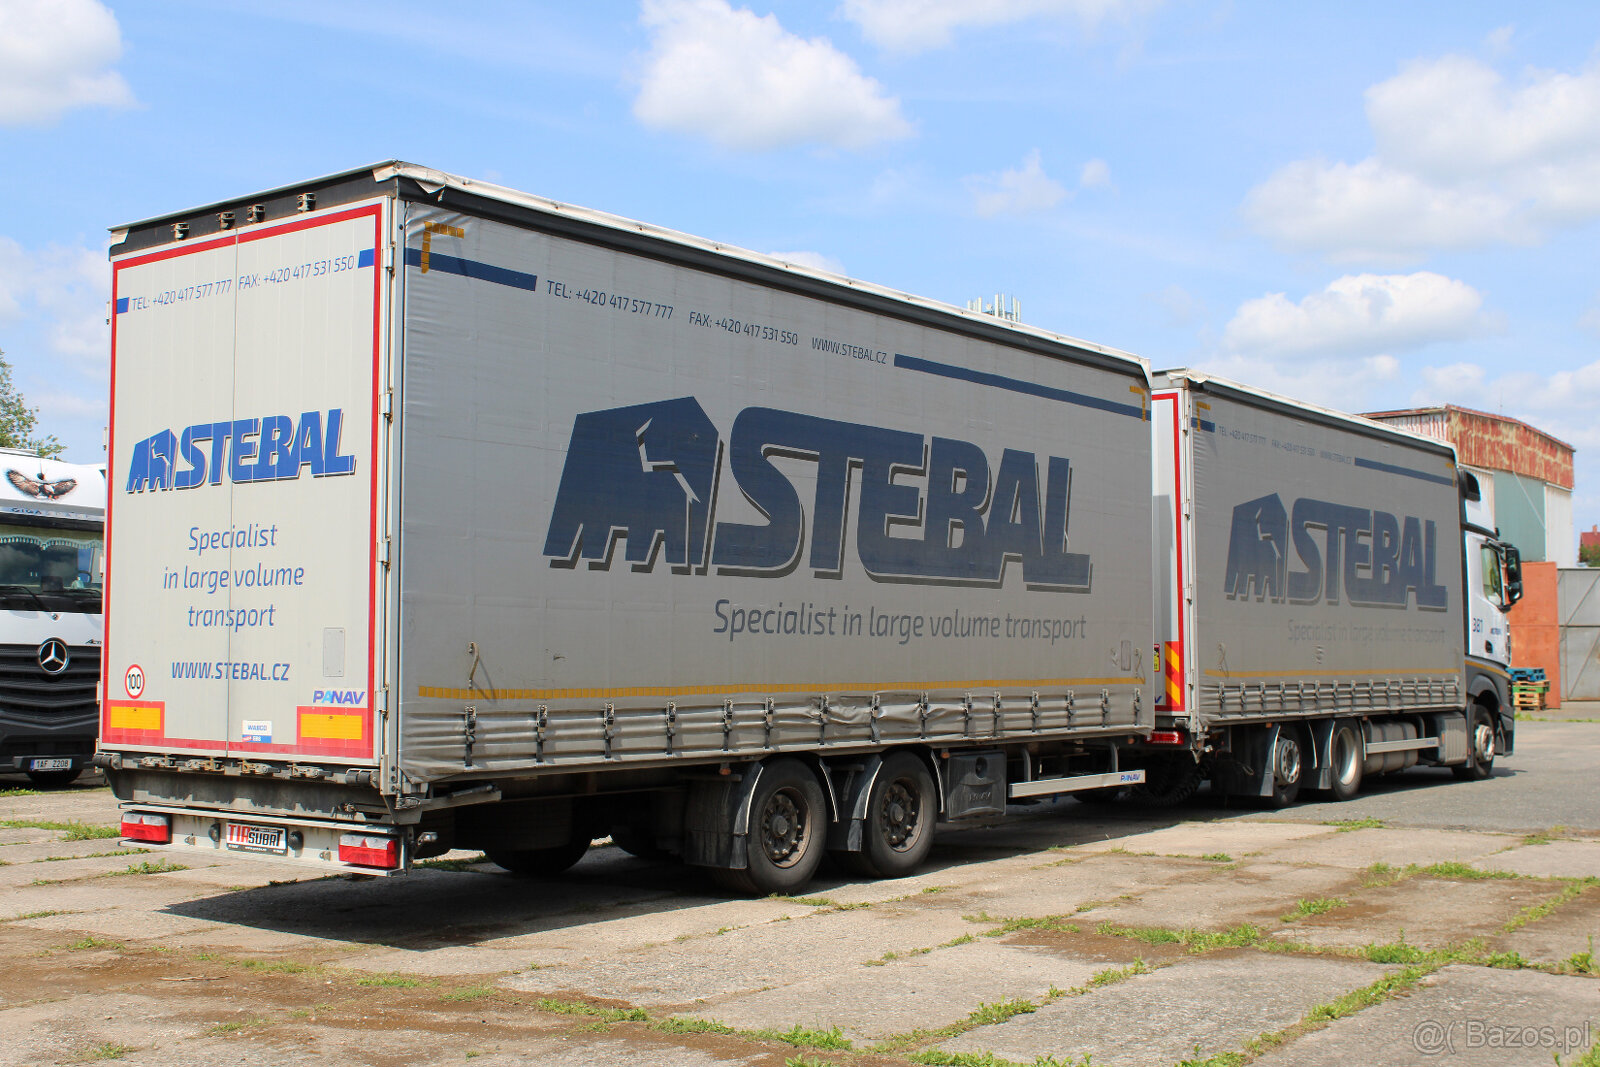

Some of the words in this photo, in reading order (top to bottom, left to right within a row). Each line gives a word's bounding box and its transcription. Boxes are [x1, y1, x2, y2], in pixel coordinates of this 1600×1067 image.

[131, 297, 150, 310] TEL:
[153, 291, 176, 306] +420
[177, 287, 194, 301] 417
[195, 283, 213, 298] 577
[215, 279, 232, 295] 777
[238, 273, 261, 290] FAX:
[263, 267, 290, 283] +420
[293, 263, 311, 279] 417
[313, 260, 331, 277] 531
[333, 255, 354, 272] 550
[547, 279, 572, 300] TEL:
[576, 288, 606, 306] +420
[609, 294, 629, 311] 417
[632, 299, 652, 315] 577
[655, 303, 674, 319] 777
[688, 311, 713, 328] FAX:
[715, 317, 741, 334] +420
[743, 323, 761, 338] 417
[762, 326, 779, 342] 531
[780, 330, 798, 346] 550
[811, 336, 887, 365] WWW.STEBAL.CZ
[175, 408, 356, 489] STEBAL
[710, 404, 1093, 594] STEBAL
[188, 523, 278, 556] Specialist
[1288, 497, 1448, 612] STEBAL
[163, 564, 180, 589] in
[183, 564, 229, 594] large
[234, 562, 305, 589] volume
[188, 604, 276, 633] transport
[713, 599, 837, 642] Specialist
[842, 605, 863, 636] in
[869, 606, 925, 645] large
[929, 609, 1002, 639] volume
[1004, 611, 1088, 647] transport
[127, 673, 142, 690] 100
[171, 661, 291, 681] WWW.STEBAL.CZ
[312, 690, 366, 705] PANAV
